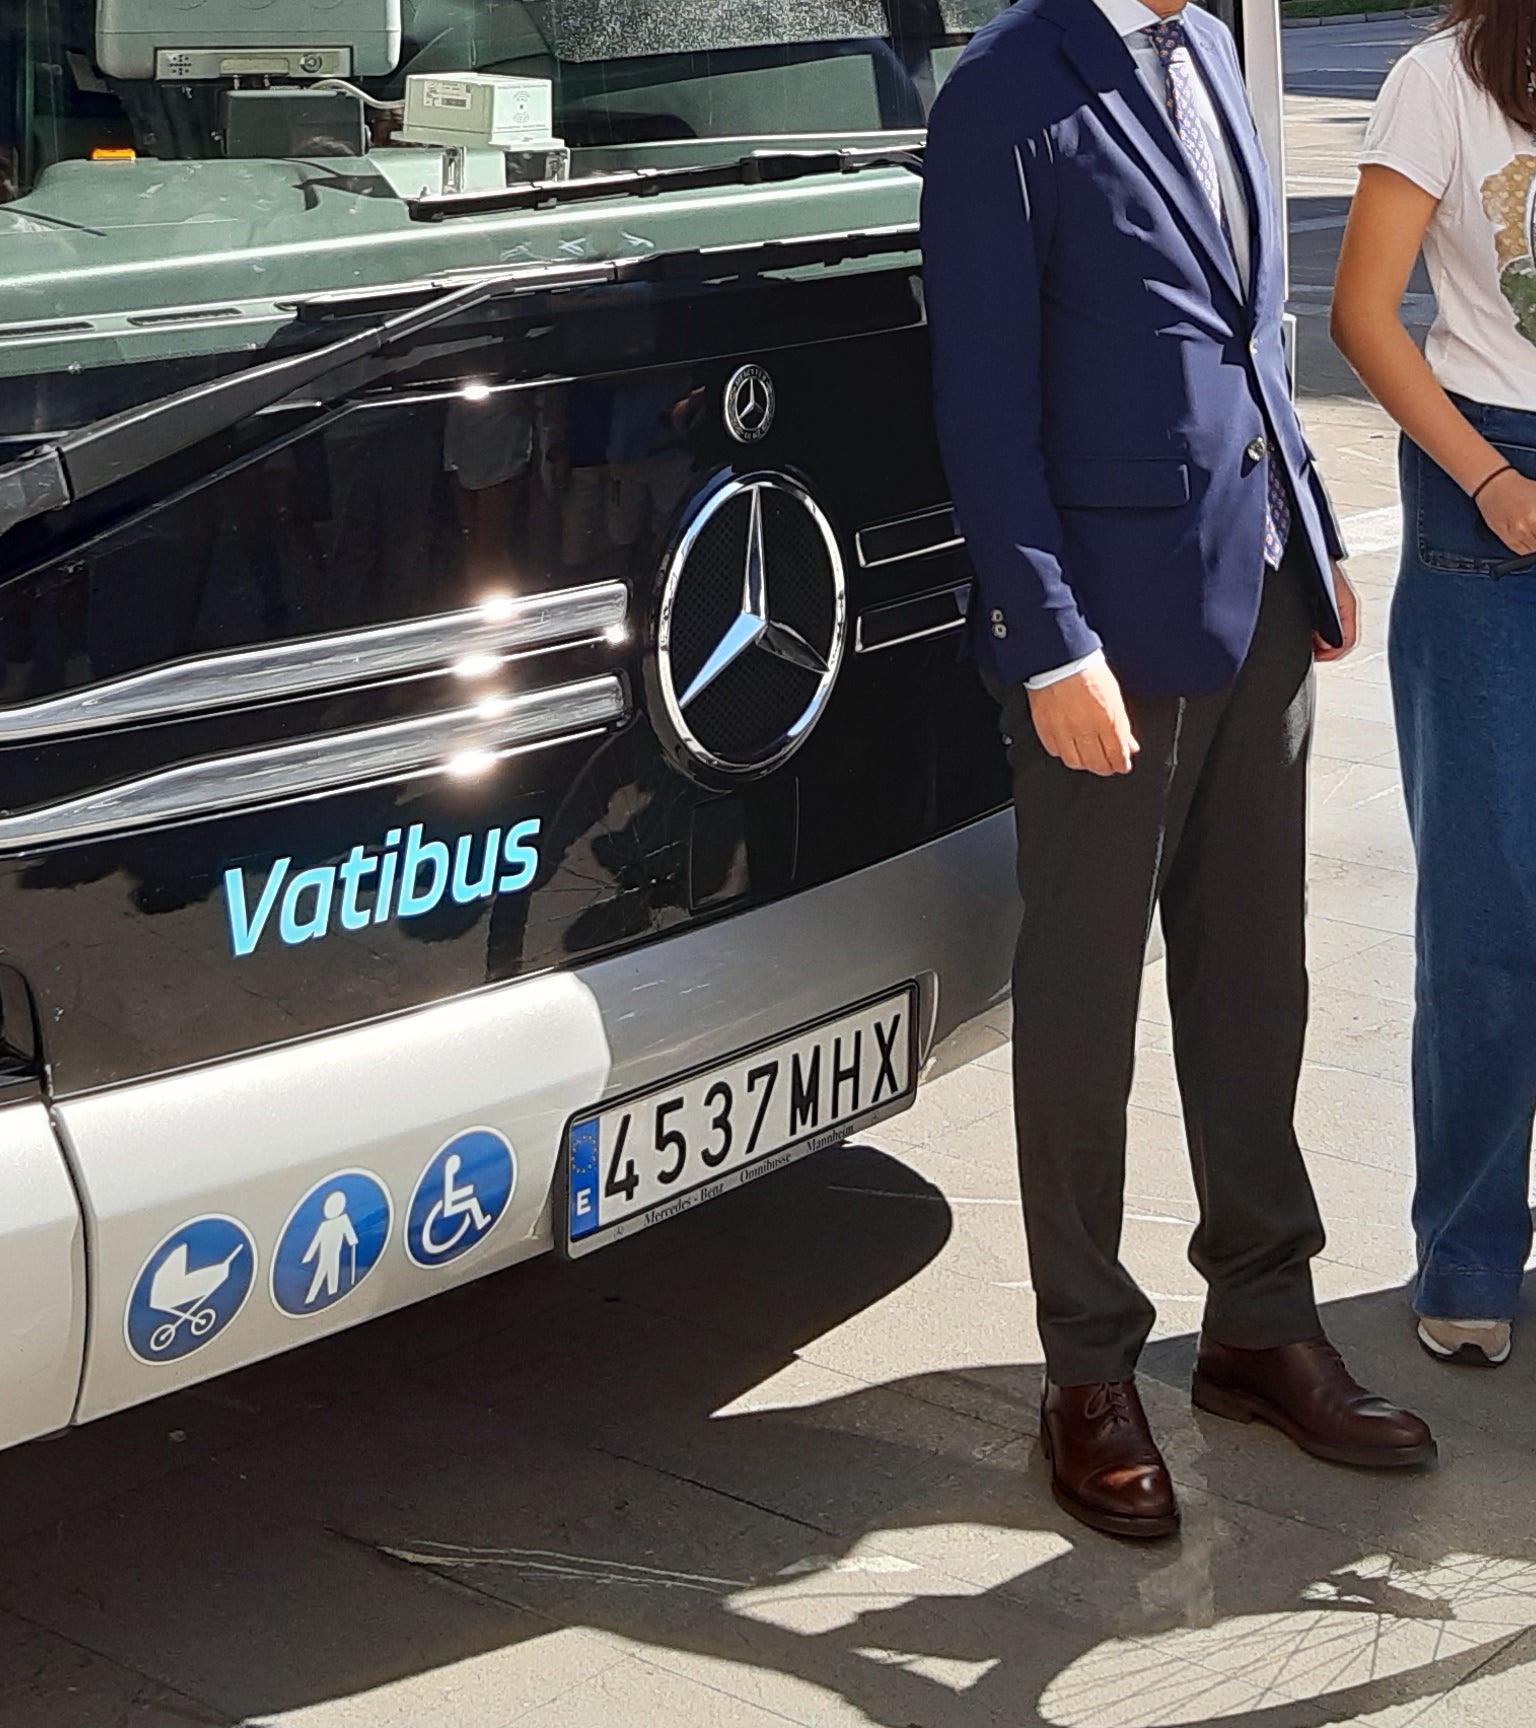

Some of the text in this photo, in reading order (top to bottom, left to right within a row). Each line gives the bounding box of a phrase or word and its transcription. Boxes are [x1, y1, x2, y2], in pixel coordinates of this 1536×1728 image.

[224, 817, 541, 957] Vatibus
[805, 1123, 855, 1155] Mannheim
[575, 1188, 592, 1217] E
